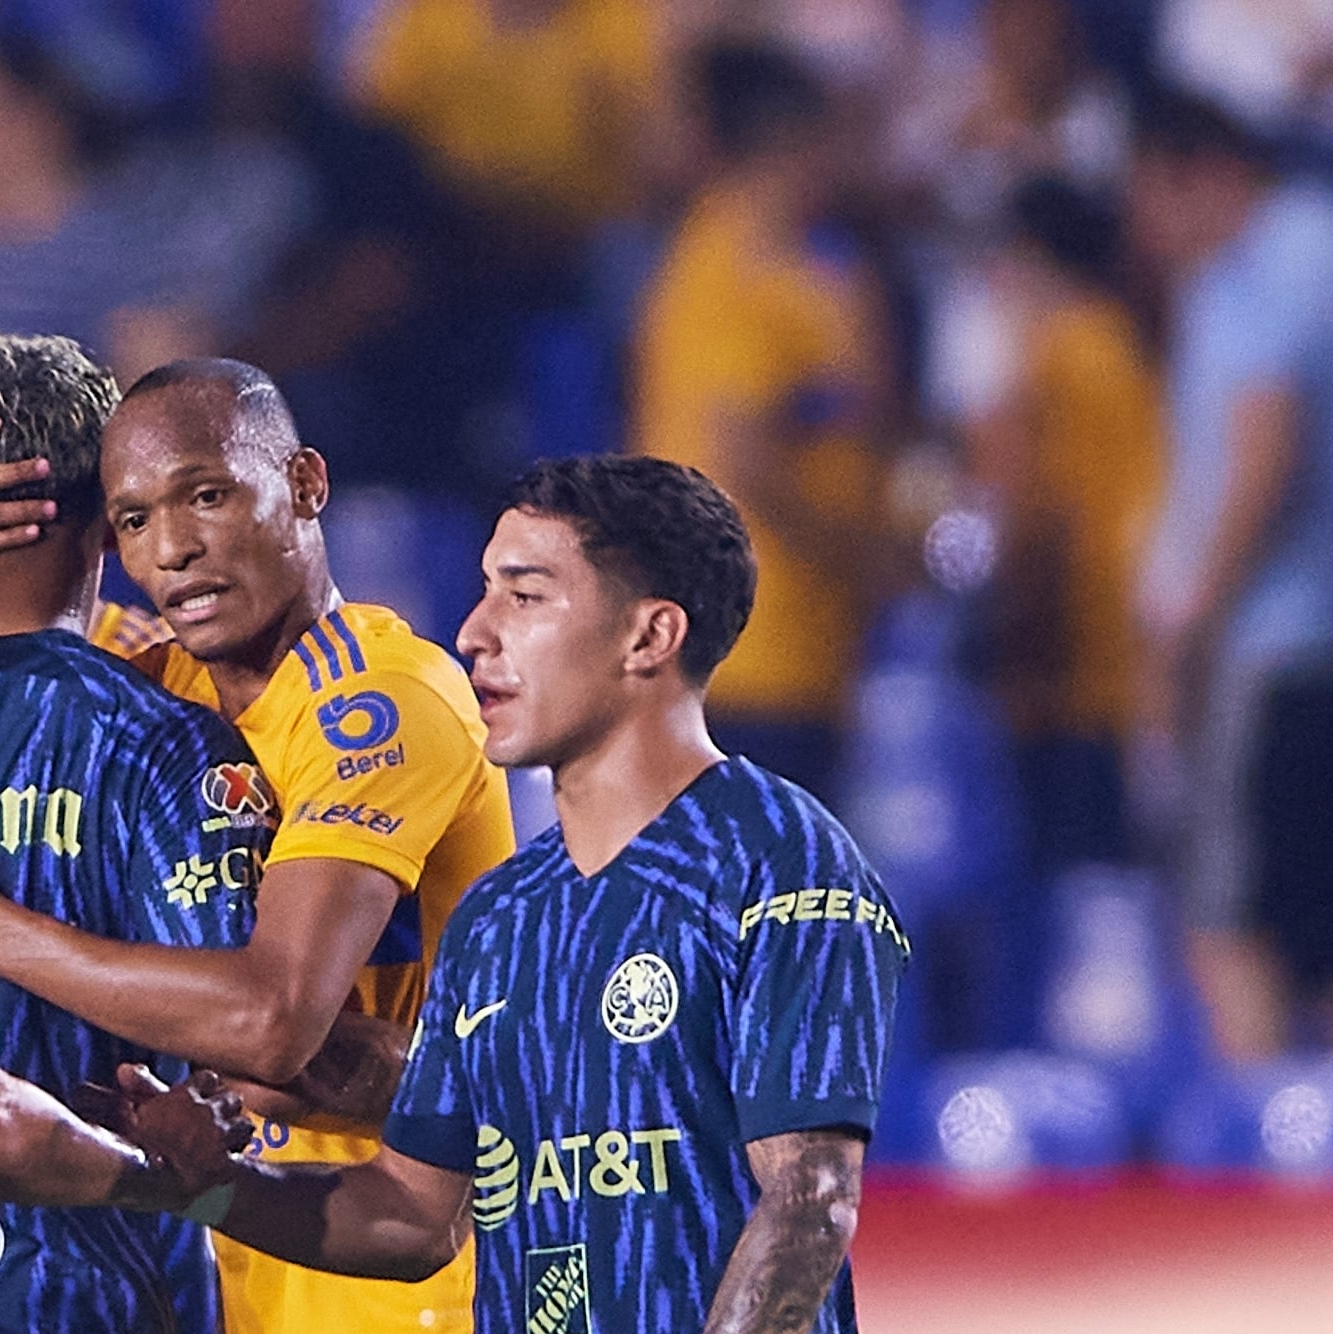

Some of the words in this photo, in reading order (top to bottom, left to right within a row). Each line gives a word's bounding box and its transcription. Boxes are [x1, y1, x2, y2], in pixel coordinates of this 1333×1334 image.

[336, 743, 406, 781] Berel
[738, 888, 853, 941] FREE
[527, 1128, 681, 1206] AT&T
